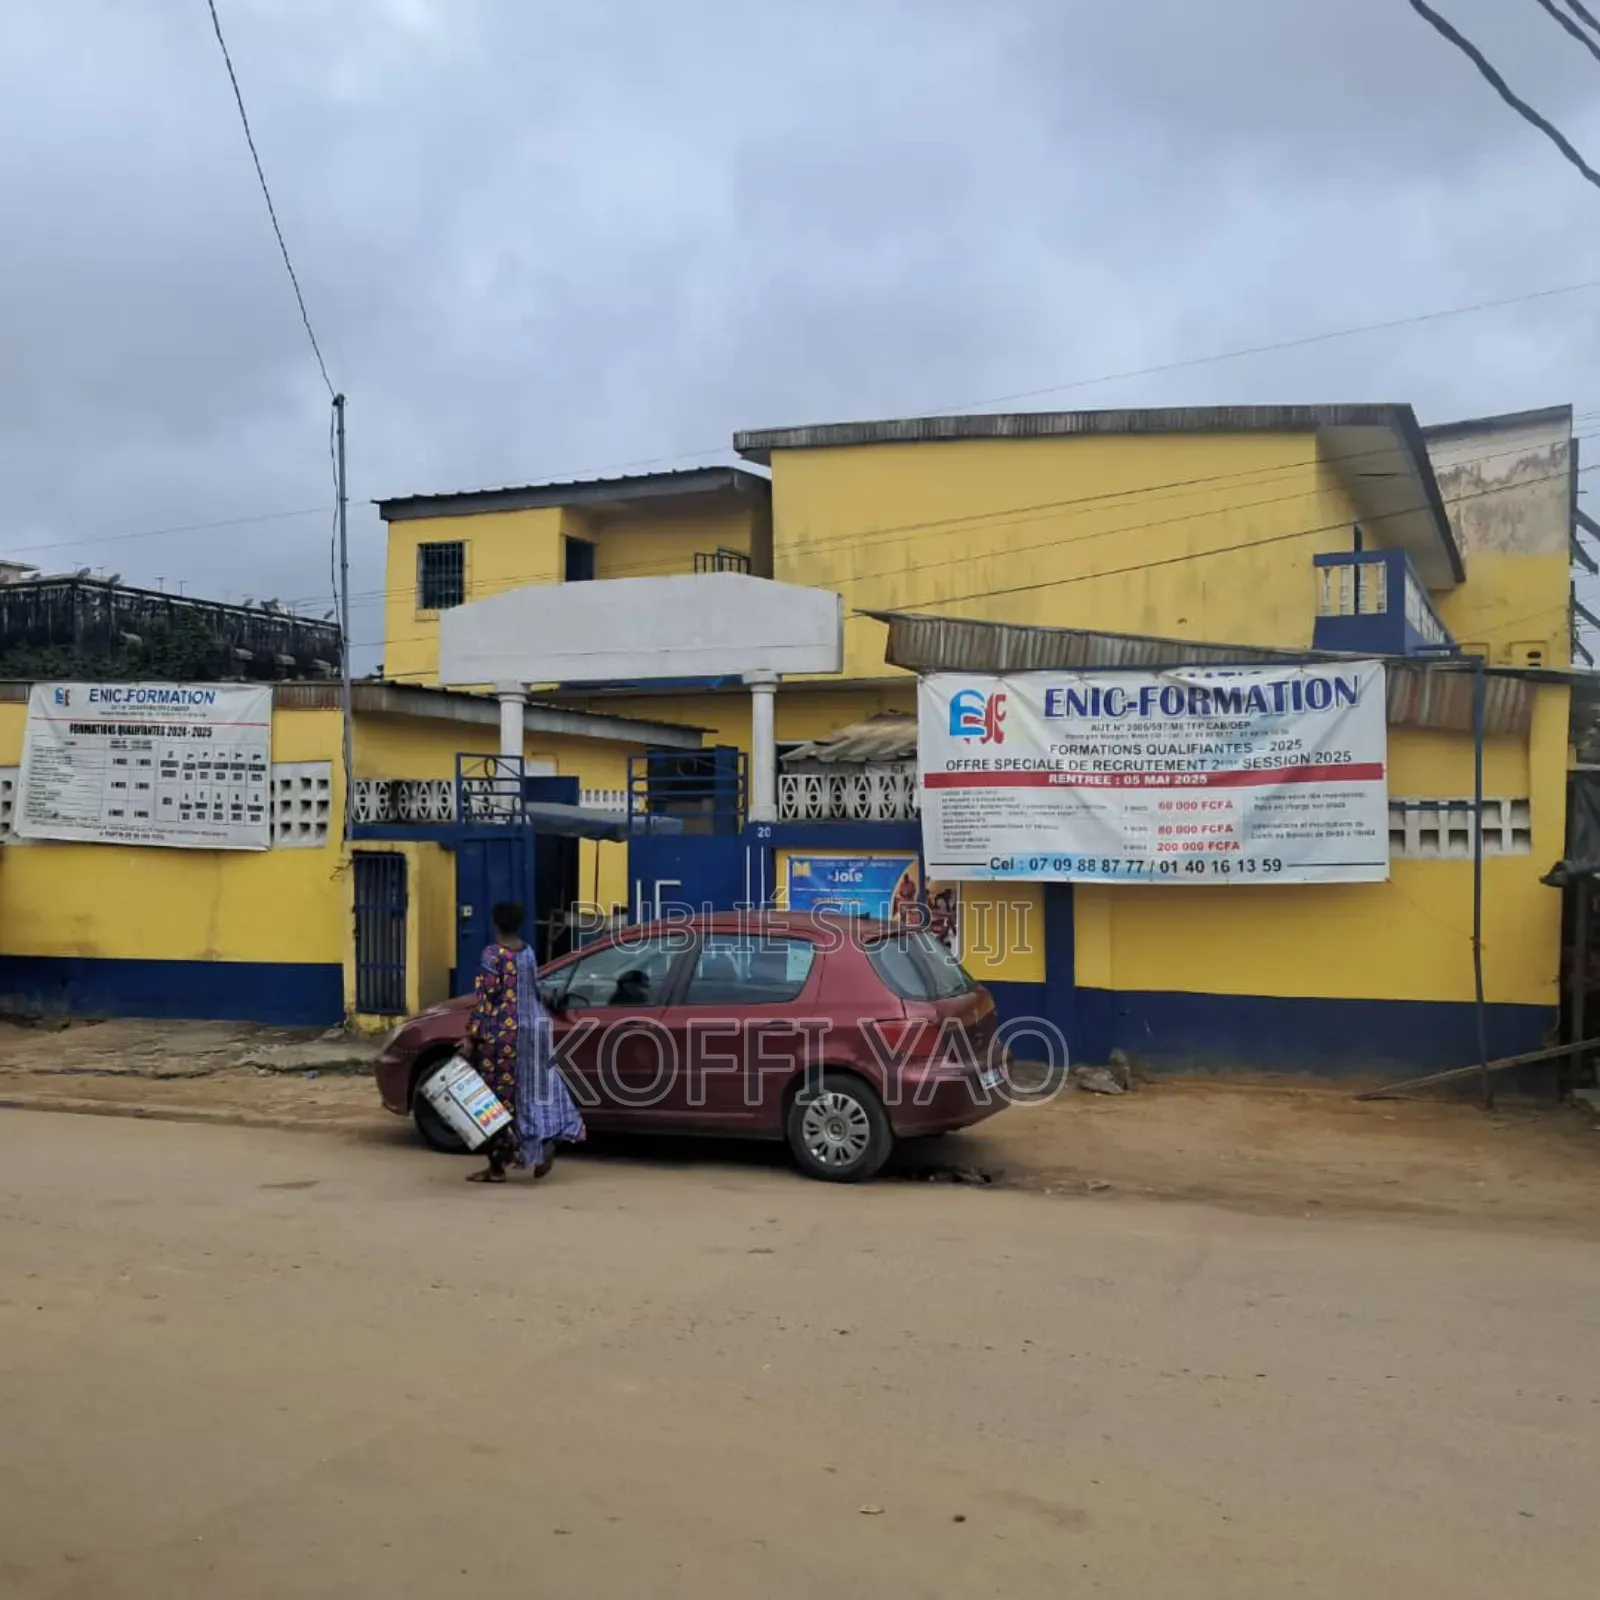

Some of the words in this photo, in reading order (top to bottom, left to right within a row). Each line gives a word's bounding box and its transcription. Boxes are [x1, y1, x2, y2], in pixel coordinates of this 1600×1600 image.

[1044, 675, 1358, 717] ENIC-FORMATION
[69, 723, 116, 736] FORMATIONS
[118, 724, 165, 737] QUALIFIANTES
[1049, 743, 1142, 756] FORMATIONS
[1145, 742, 1253, 756] QUALIFIANTES
[1270, 739, 1303, 752] 2025
[946, 759, 991, 771] OFFRE
[994, 758, 1065, 770] SPECIALE
[1068, 759, 1089, 771] DE
[1092, 758, 1207, 771] RECRUTEMENT
[1243, 751, 1310, 769] SESSION
[1315, 750, 1352, 764] 2025
[1123, 774, 1140, 785] 05
[1144, 774, 1170, 785] MAI
[1174, 773, 1208, 785] 2025
[1175, 800, 1198, 811] 000
[1201, 799, 1234, 810] FCFA
[757, 826, 772, 838] 20
[1175, 824, 1198, 835] 000
[1201, 823, 1234, 834] FCFA
[1156, 842, 1179, 852] 200
[1182, 841, 1205, 852] 000
[1208, 840, 1241, 851] FCFA
[990, 857, 1015, 871] Cel
[1029, 858, 1048, 871] 07
[1053, 858, 1072, 871] 09
[1076, 859, 1096, 873] 88
[1101, 859, 1121, 873] 87
[1125, 859, 1145, 874] 77
[1159, 860, 1179, 874] 01
[1184, 860, 1205, 874] 40
[1211, 859, 1231, 874] 16
[1237, 859, 1257, 873] 13
[1262, 858, 1282, 873] 59
